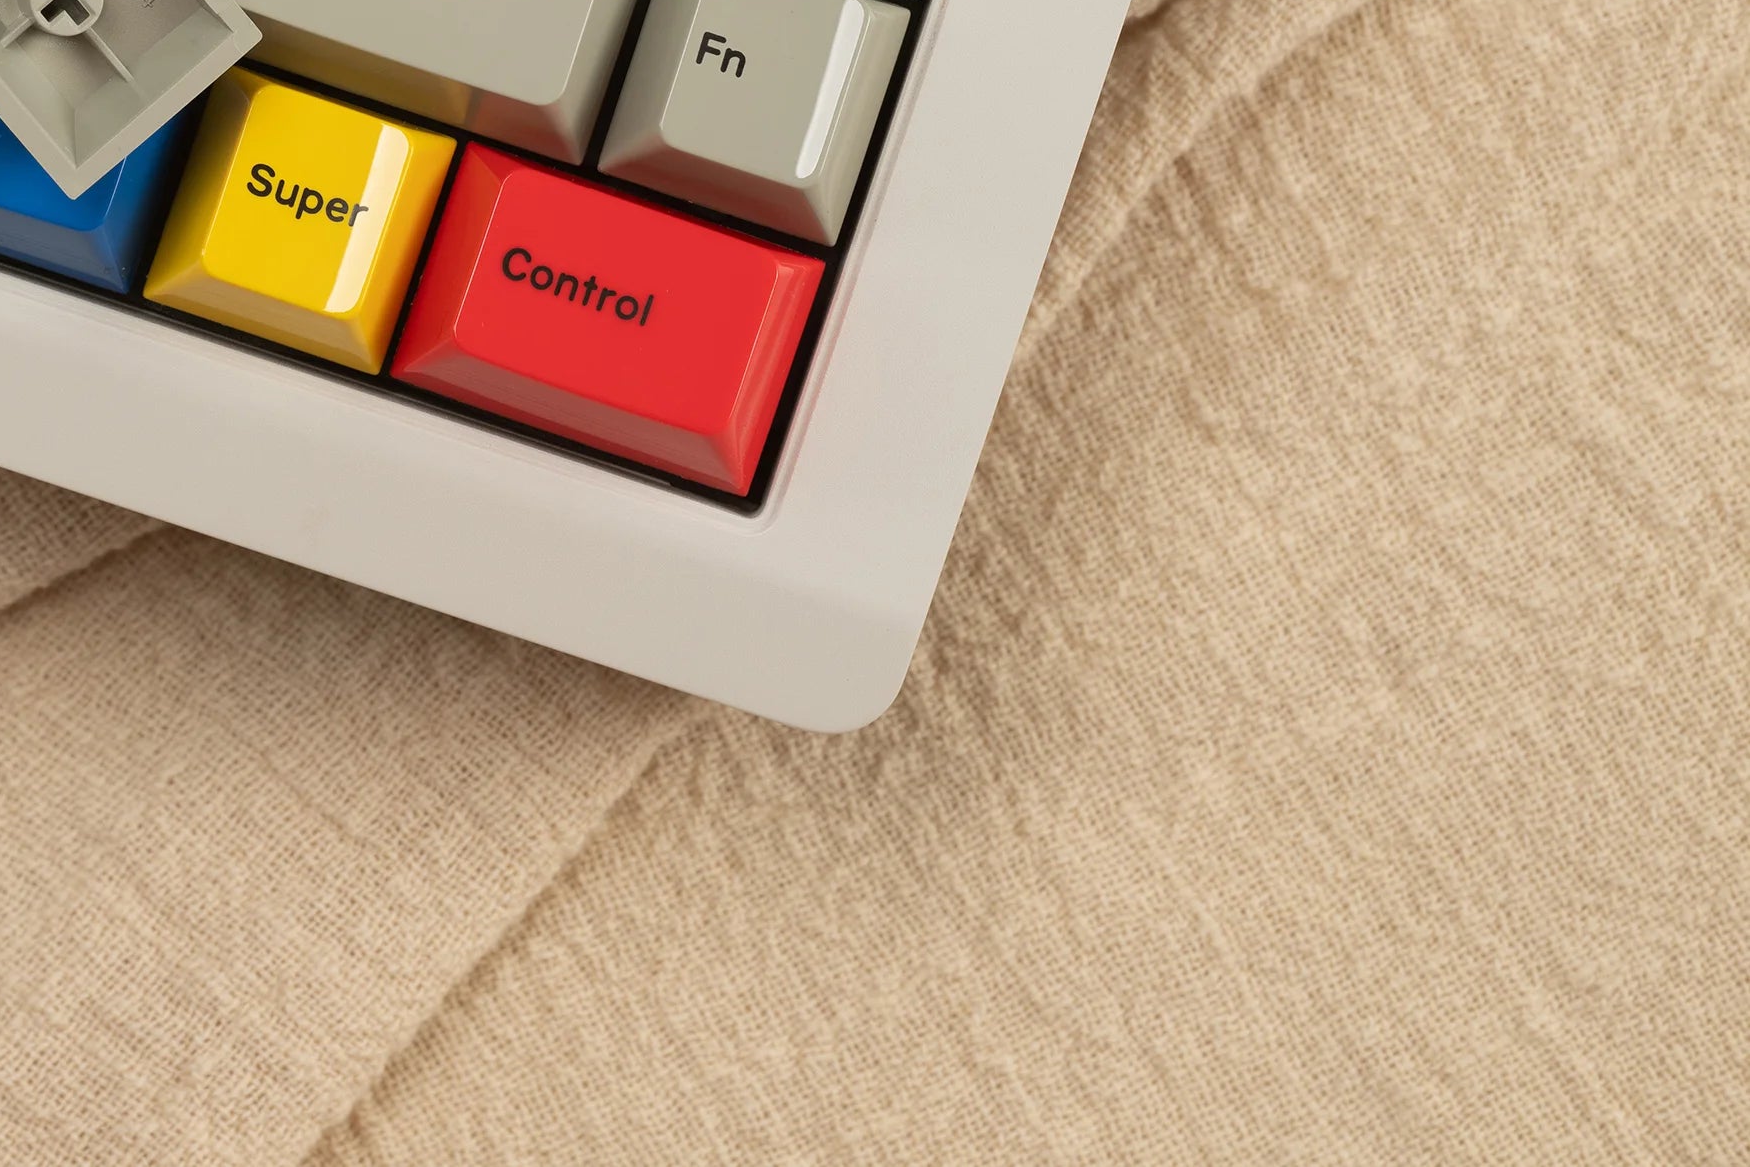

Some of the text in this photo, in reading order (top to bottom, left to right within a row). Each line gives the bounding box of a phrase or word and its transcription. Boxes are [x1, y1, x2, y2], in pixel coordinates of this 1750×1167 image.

[696, 32, 746, 78] Fn
[247, 164, 368, 226] Super
[502, 248, 654, 326] Control
